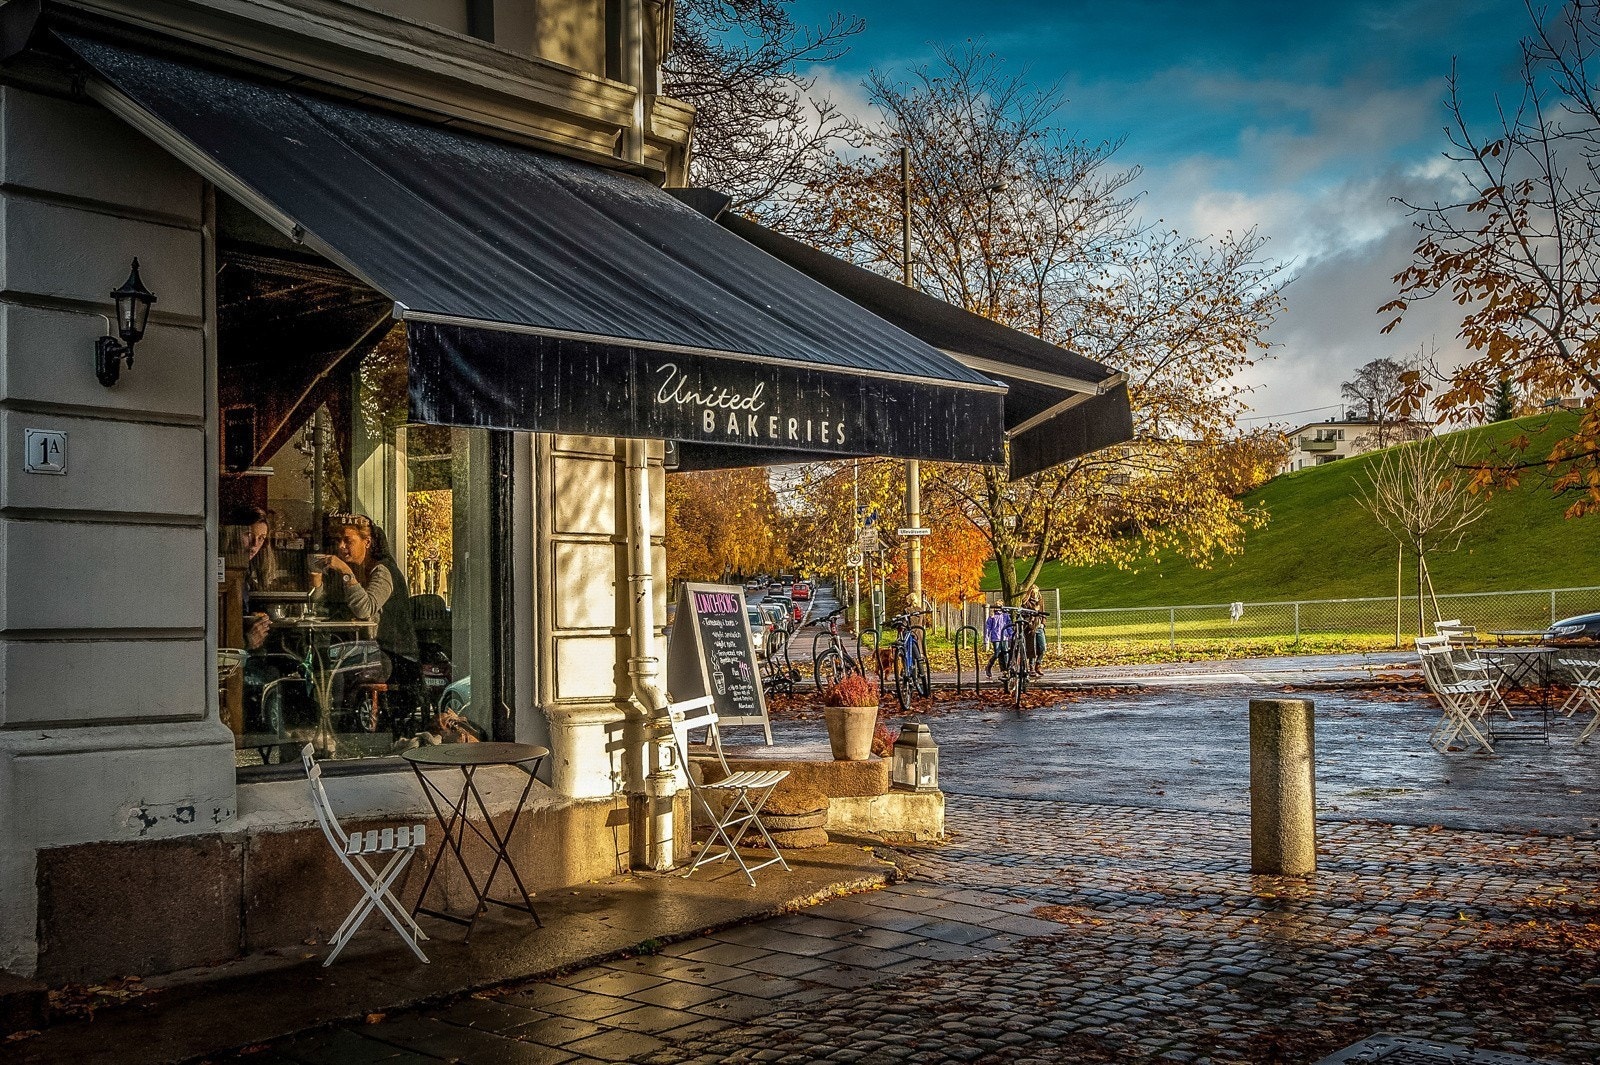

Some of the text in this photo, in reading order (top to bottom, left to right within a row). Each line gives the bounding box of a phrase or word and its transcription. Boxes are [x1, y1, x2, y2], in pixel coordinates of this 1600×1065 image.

[656, 363, 765, 412] United
[703, 409, 846, 445] BAKERIES
[40, 437, 60, 465] 1A
